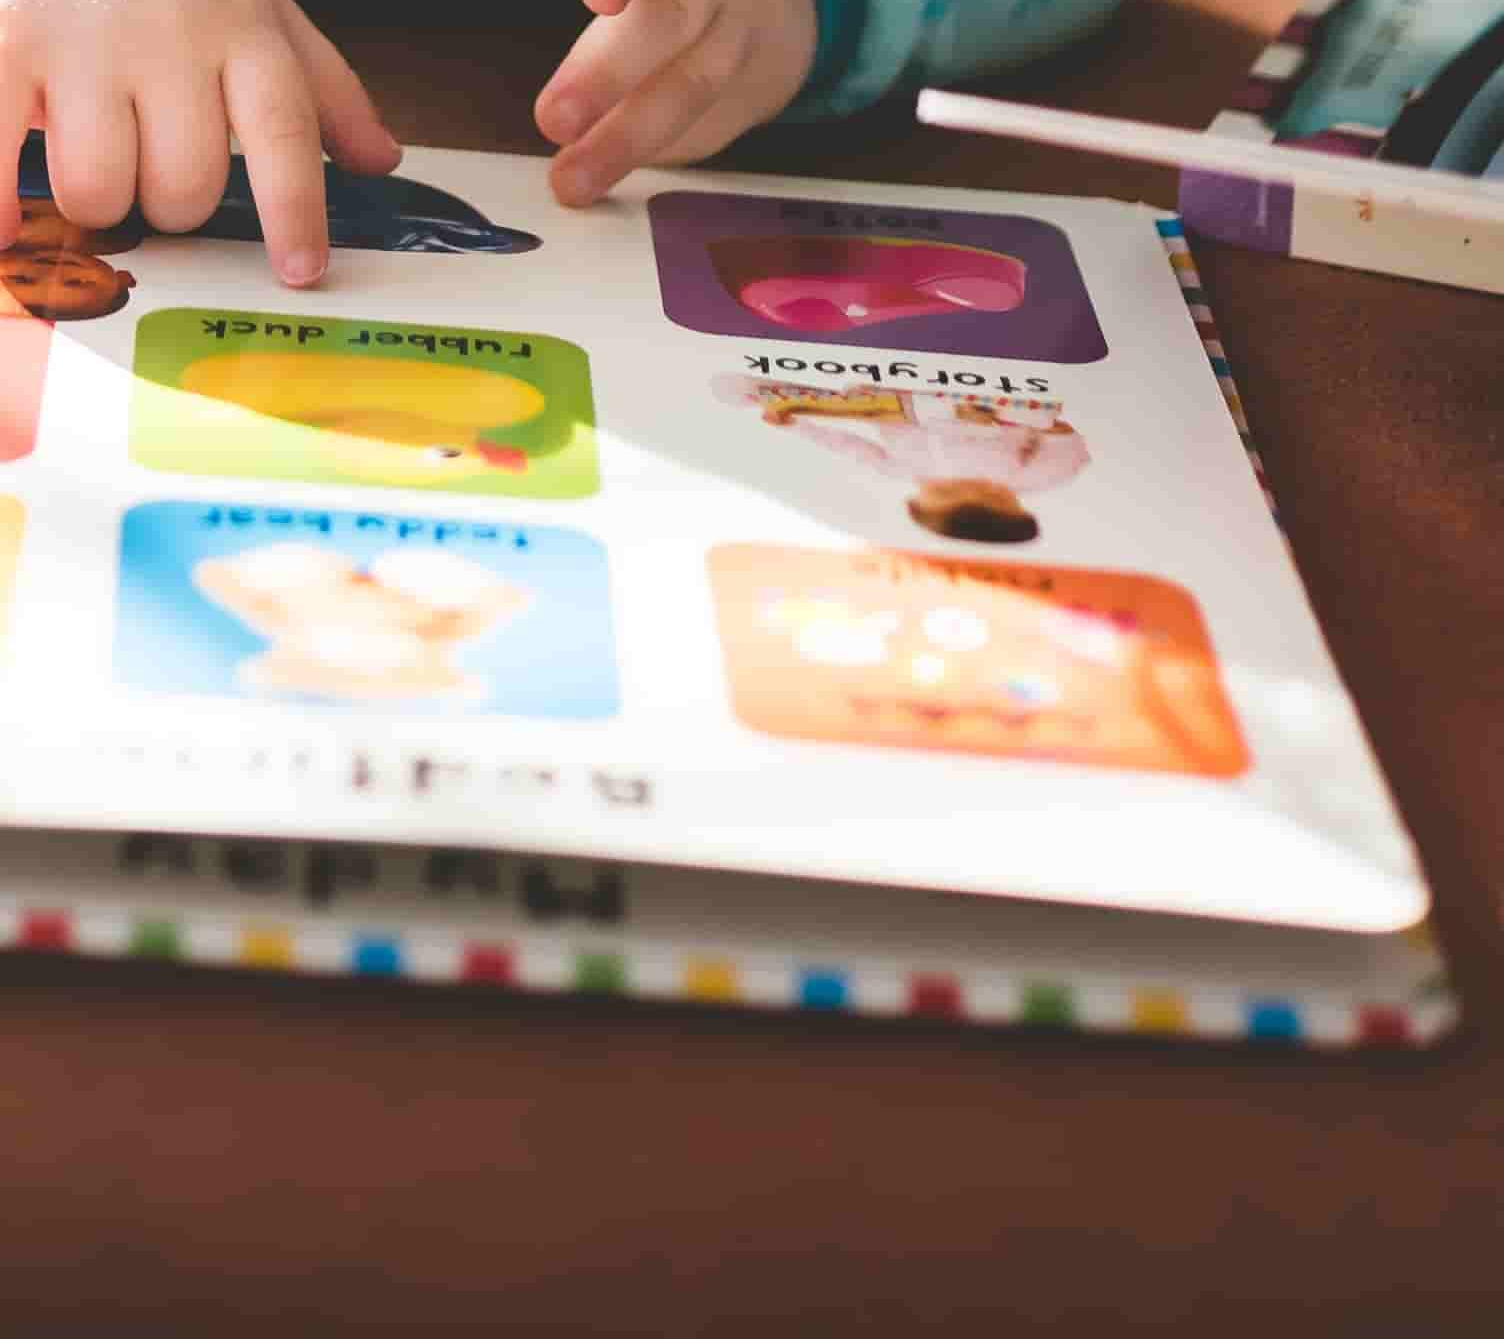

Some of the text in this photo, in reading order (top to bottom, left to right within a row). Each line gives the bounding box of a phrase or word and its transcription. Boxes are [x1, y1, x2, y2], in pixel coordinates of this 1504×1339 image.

[199, 317, 532, 362] rubber duck
[741, 353, 1050, 396] storybook
[196, 505, 531, 551] teddy bear
[116, 833, 630, 928] My day
